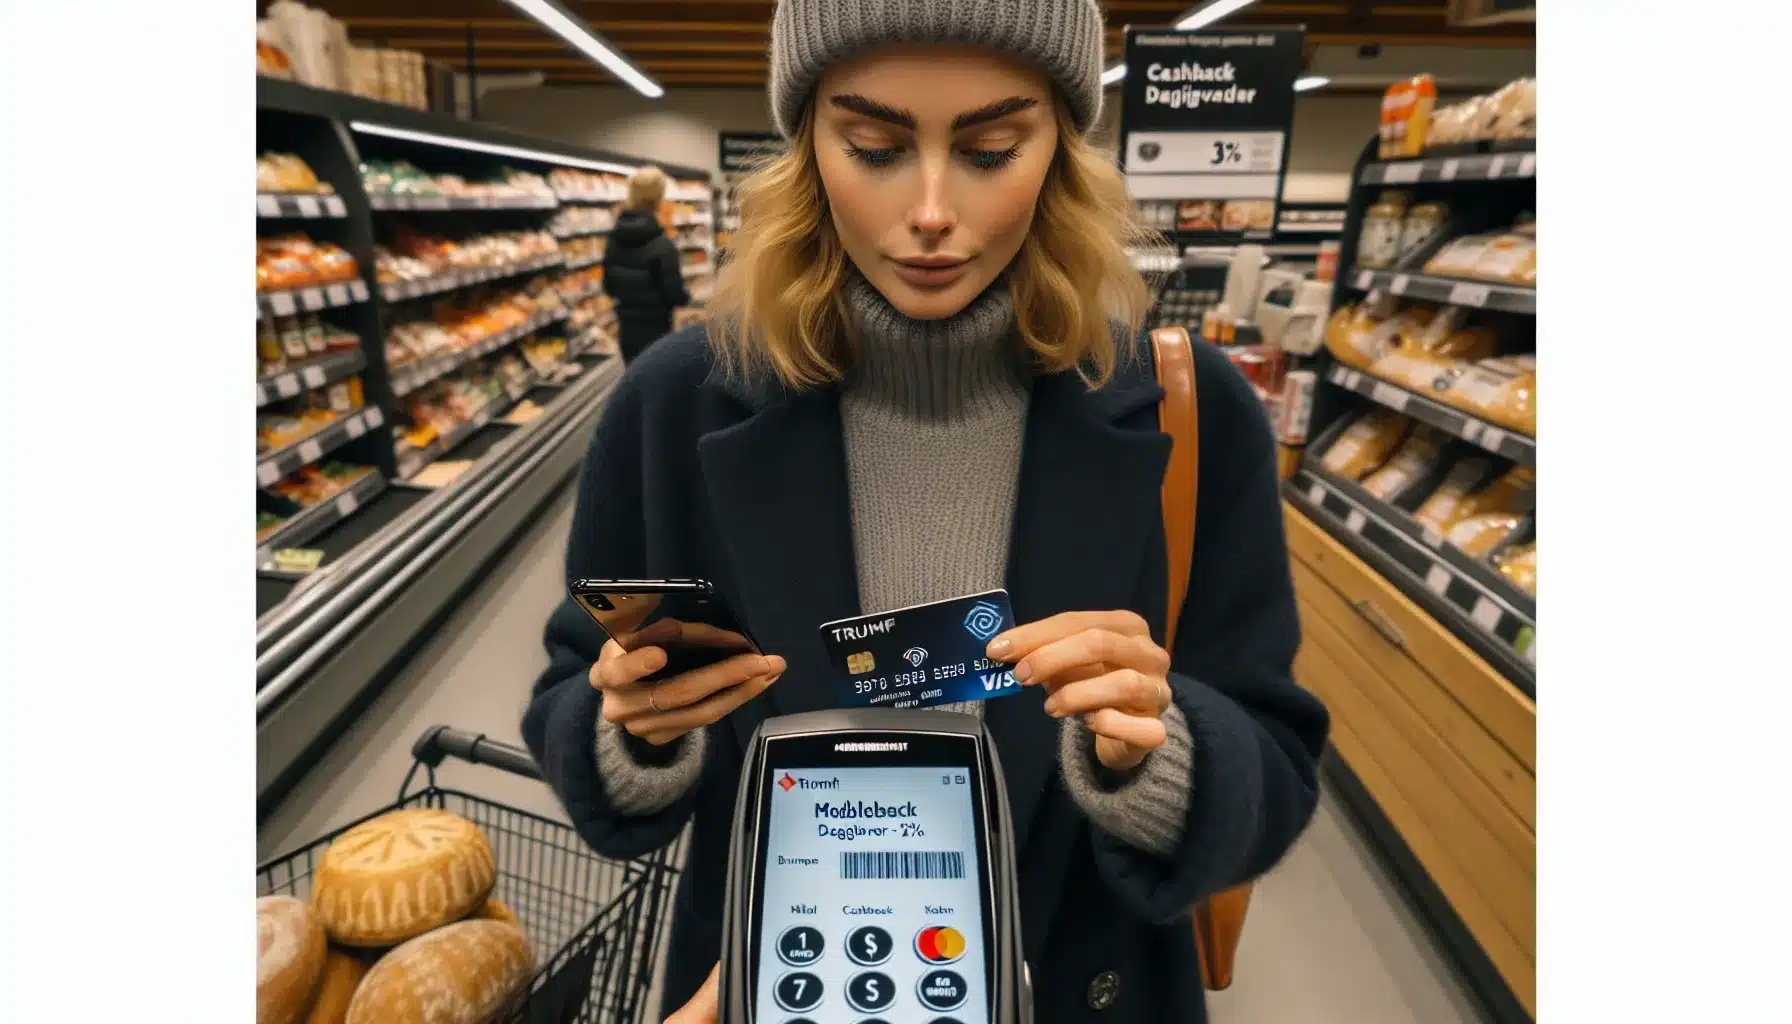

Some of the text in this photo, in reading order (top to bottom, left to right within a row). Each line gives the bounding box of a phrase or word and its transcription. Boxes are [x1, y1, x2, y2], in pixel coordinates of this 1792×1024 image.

[1147, 61, 1236, 82] Cashback
[1210, 141, 1242, 165] 3%
[798, 932, 806, 948] 1
[793, 980, 807, 1000] 7
